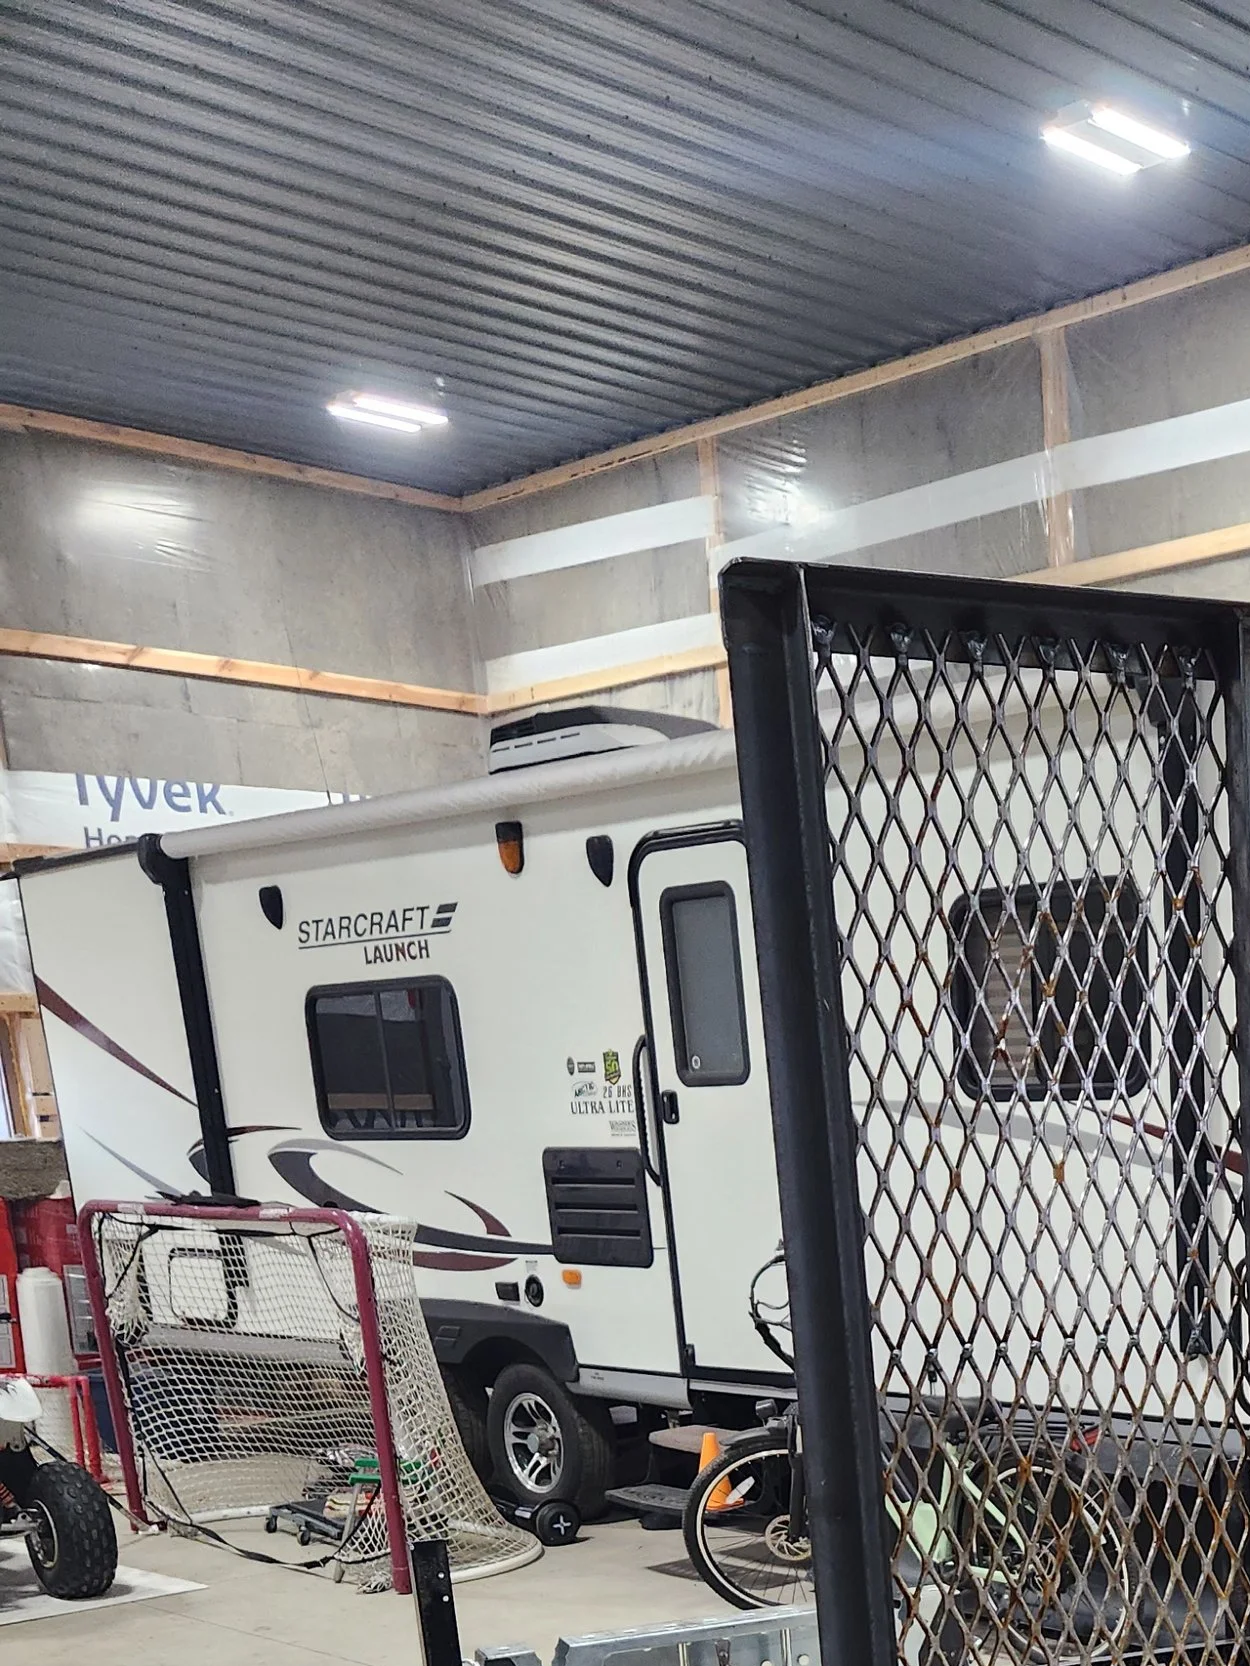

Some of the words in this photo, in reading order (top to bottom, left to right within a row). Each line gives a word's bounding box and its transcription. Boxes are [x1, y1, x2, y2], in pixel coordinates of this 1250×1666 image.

[298, 905, 430, 944] STARCRAFT
[363, 939, 430, 965] LAUNCH
[603, 1085, 613, 1099] 26
[570, 1100, 605, 1115] ULTRA
[608, 1100, 634, 1114] LITE
